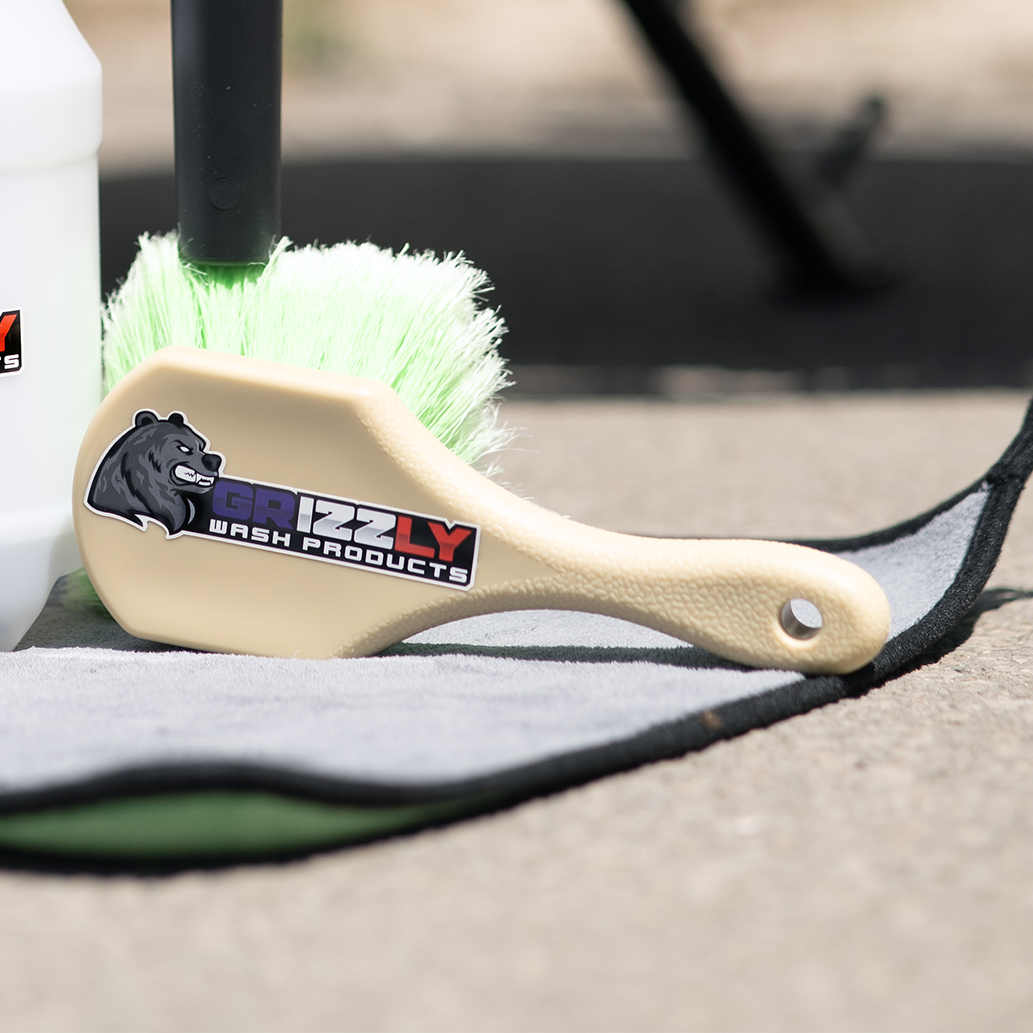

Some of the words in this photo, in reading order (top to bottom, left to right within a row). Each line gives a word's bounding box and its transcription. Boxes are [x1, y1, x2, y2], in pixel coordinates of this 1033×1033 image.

[208, 518, 291, 548] WASH
[302, 536, 469, 584] PRODUCTS
[211, 479, 473, 563] GRIZZLY
